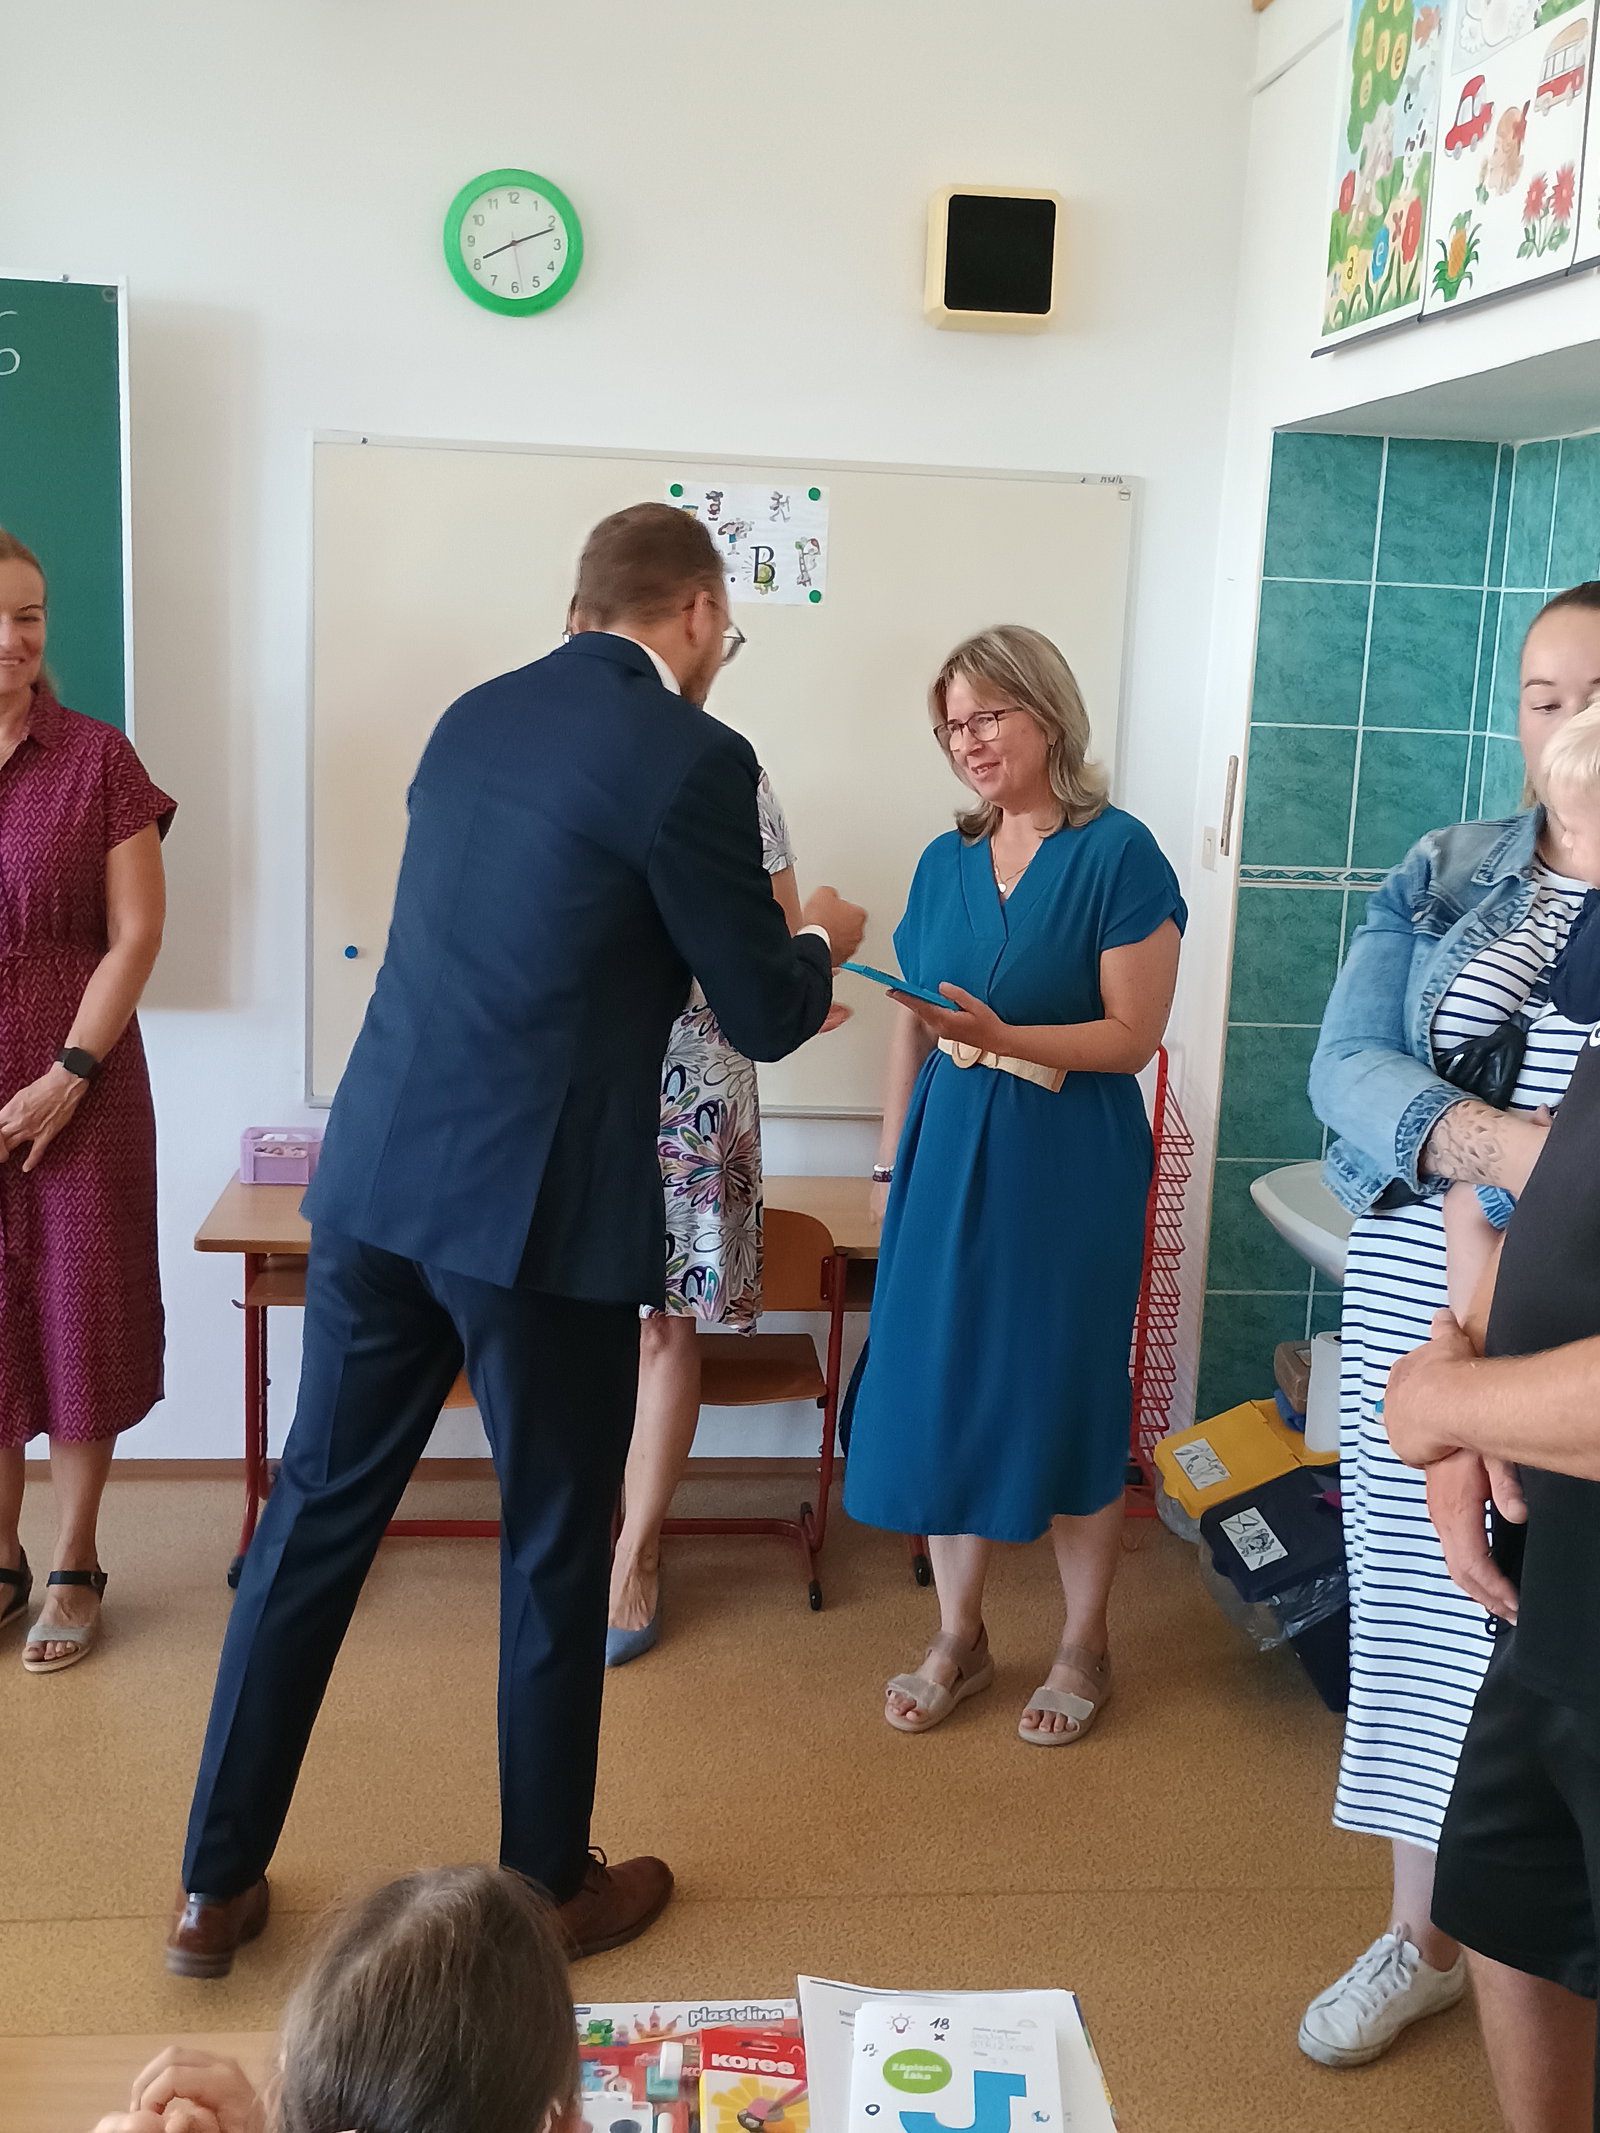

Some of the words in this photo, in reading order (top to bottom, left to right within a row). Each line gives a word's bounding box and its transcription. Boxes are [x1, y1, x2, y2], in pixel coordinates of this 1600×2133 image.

[488, 198, 499, 210] 11
[507, 191, 520, 204] 12
[533, 200, 539, 211] 1
[473, 214, 485, 227] 10
[548, 215, 556, 228] 2
[467, 235, 476, 248] 9
[553, 238, 561, 251] 3
[1376, 242, 1384, 266] e
[473, 258, 482, 271] 8
[546, 260, 555, 272] 4
[490, 274, 498, 286] 7
[532, 275, 541, 288] 5
[511, 281, 519, 294] 6
[750, 545, 776, 584] B
[688, 2005, 785, 2027] plastelina
[929, 2017, 950, 2031] 18
